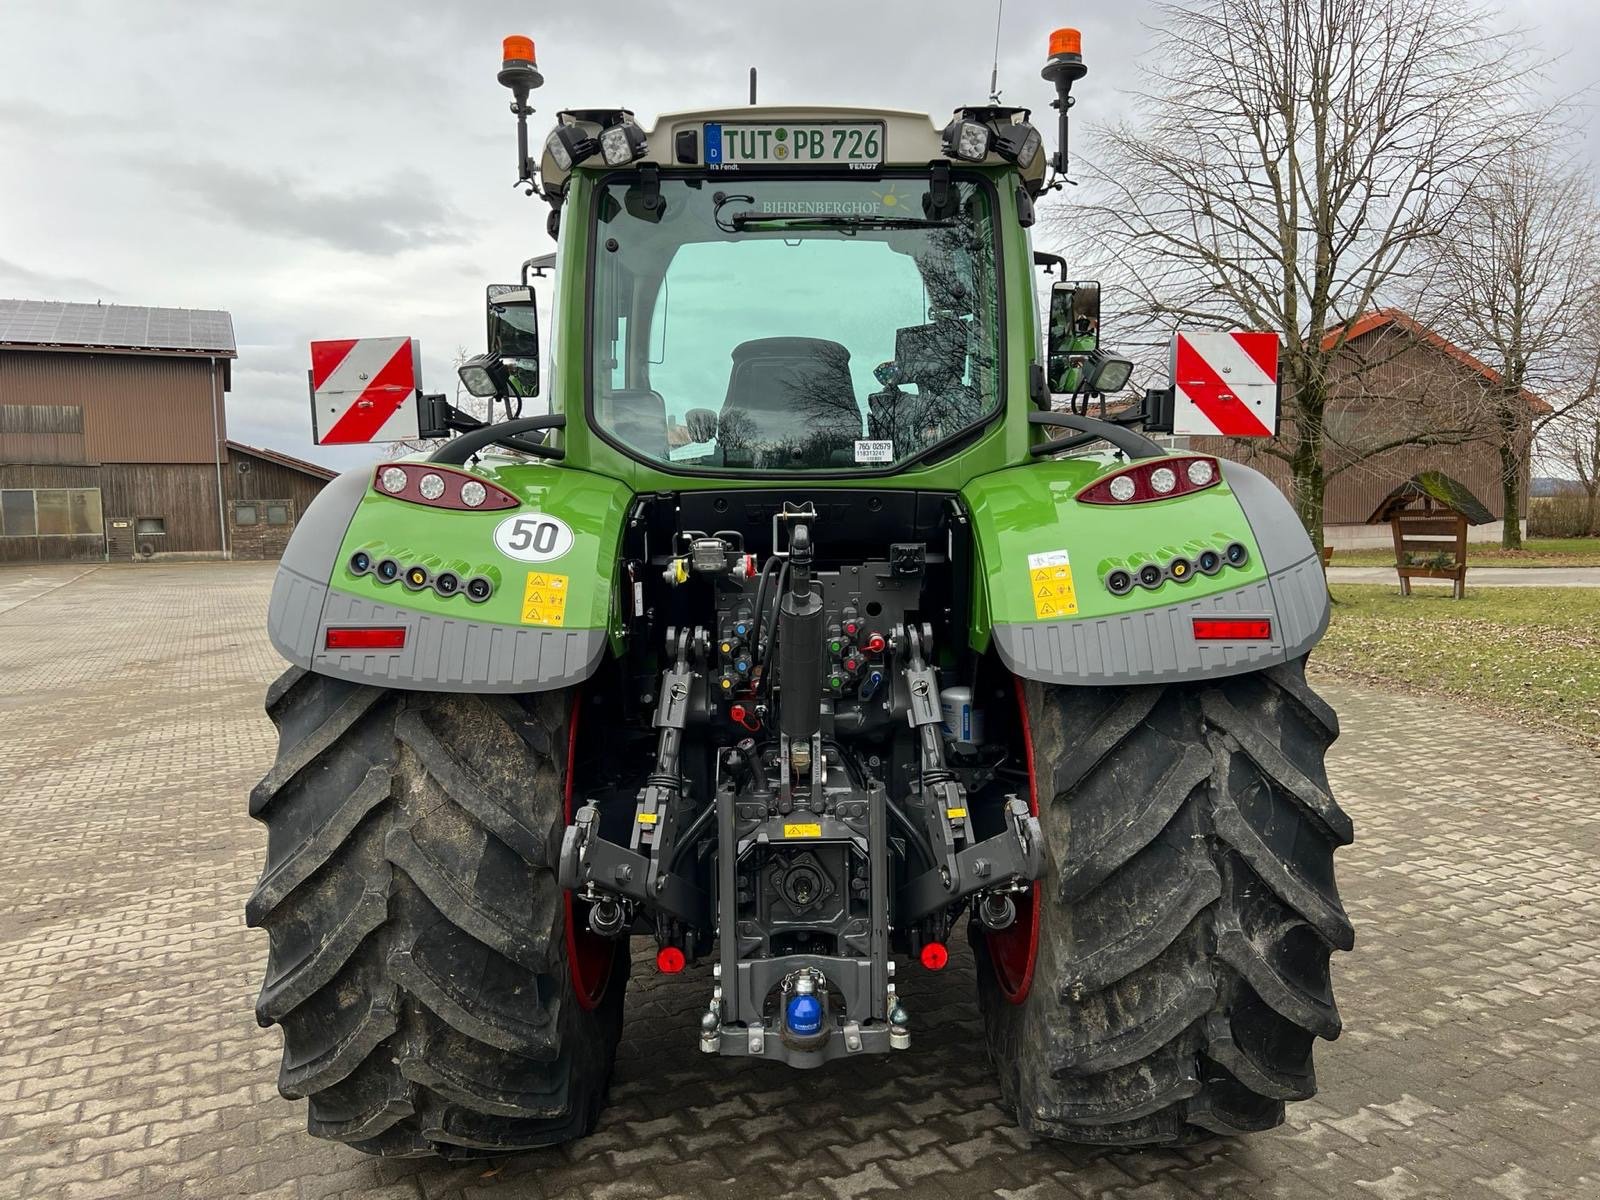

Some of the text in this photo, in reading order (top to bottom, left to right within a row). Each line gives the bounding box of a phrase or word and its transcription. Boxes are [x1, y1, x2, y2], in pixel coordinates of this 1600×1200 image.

[710, 148, 718, 158] D
[724, 129, 879, 159] TUT PB 726
[508, 519, 559, 554] 50
